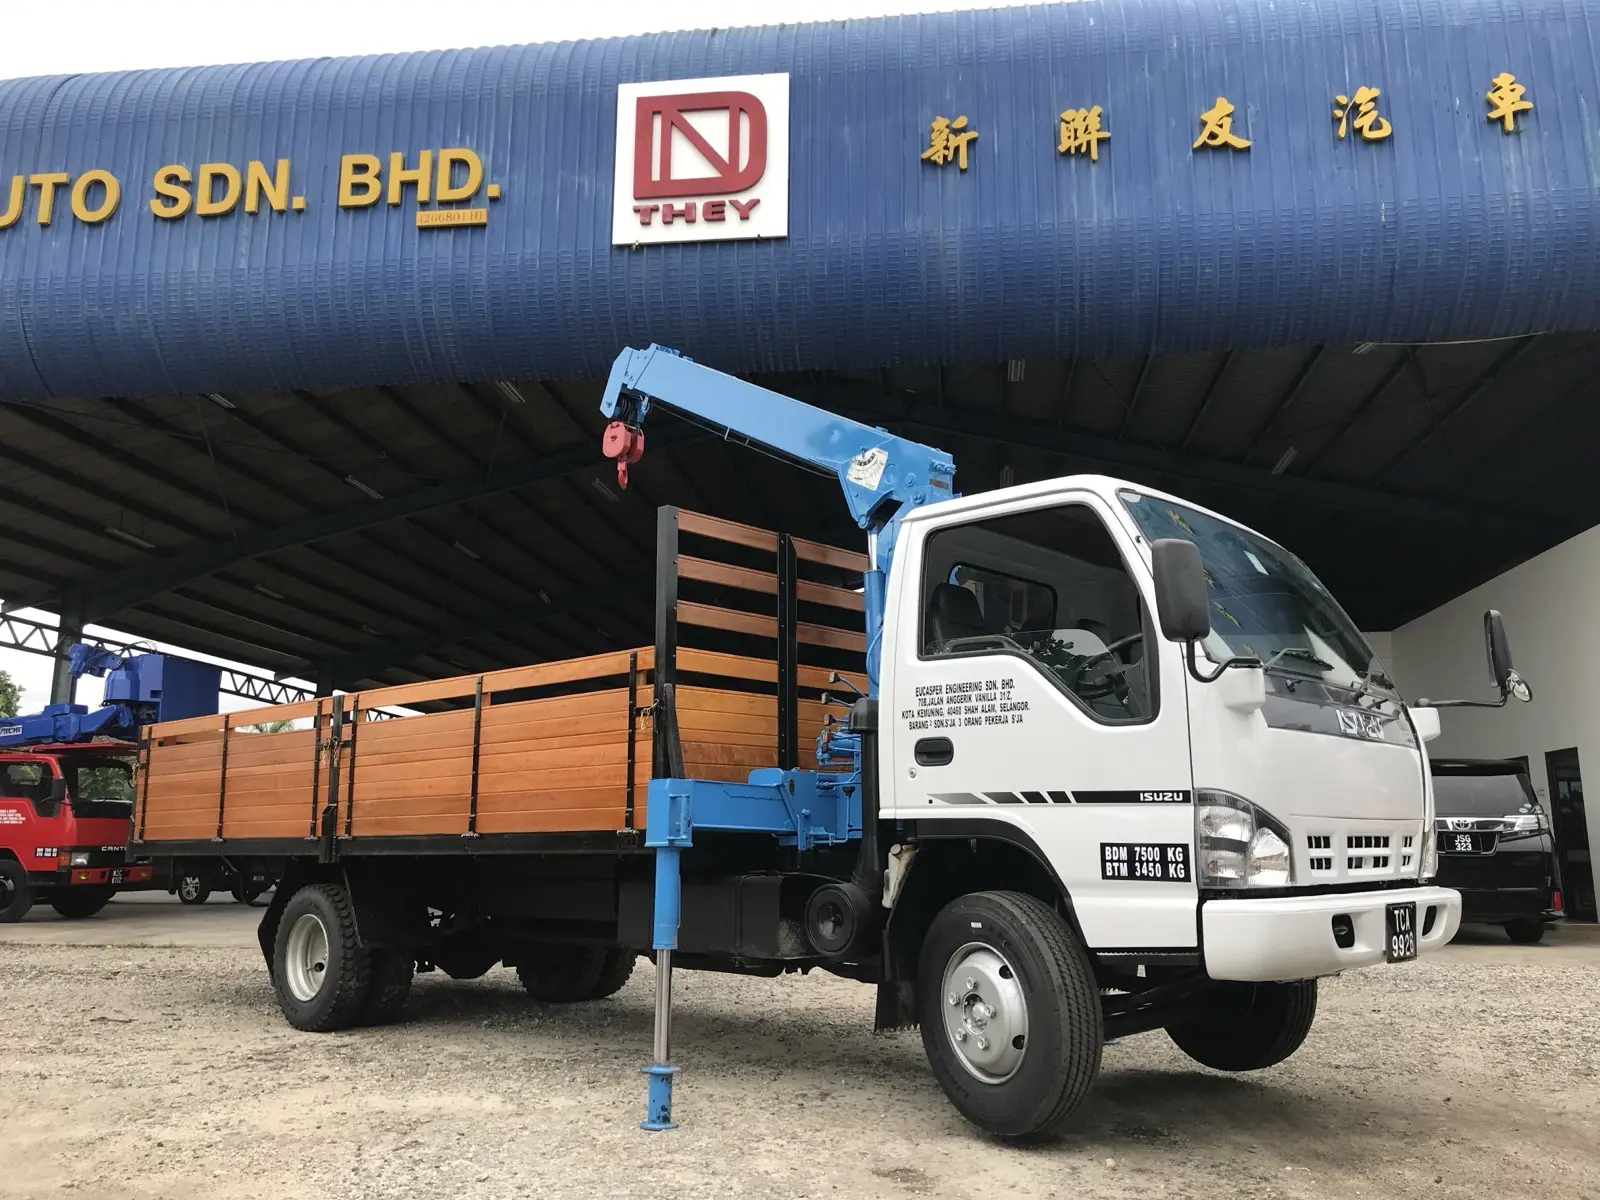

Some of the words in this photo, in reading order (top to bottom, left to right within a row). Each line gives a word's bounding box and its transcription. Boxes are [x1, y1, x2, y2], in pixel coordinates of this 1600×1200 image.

[150, 158, 306, 220] SDN.
[338, 147, 501, 209] BHD.
[632, 198, 761, 226] THEY
[915, 685, 943, 697] EUCASPER
[945, 681, 983, 694] ENGINEERING
[985, 680, 999, 692] SDN.
[1001, 678, 1015, 690] BHD.
[946, 694, 973, 705] ANGGERIK
[975, 691, 997, 703] VANILLA
[901, 708, 915, 719] KOTA
[964, 704, 979, 715] SHAH
[964, 716, 983, 727] ORANG
[984, 714, 1009, 725] PEKERJA
[1139, 792, 1183, 802] ISUZU
[1454, 834, 1472, 843] JSG
[1105, 846, 1128, 861] BDM
[1134, 846, 1161, 862] 7500
[1167, 847, 1184, 862] KG
[1454, 842, 1472, 851] 323
[1105, 862, 1129, 877] BTM
[1134, 862, 1162, 878] 3450
[1168, 863, 1186, 879] KG
[1393, 908, 1411, 933] TCA
